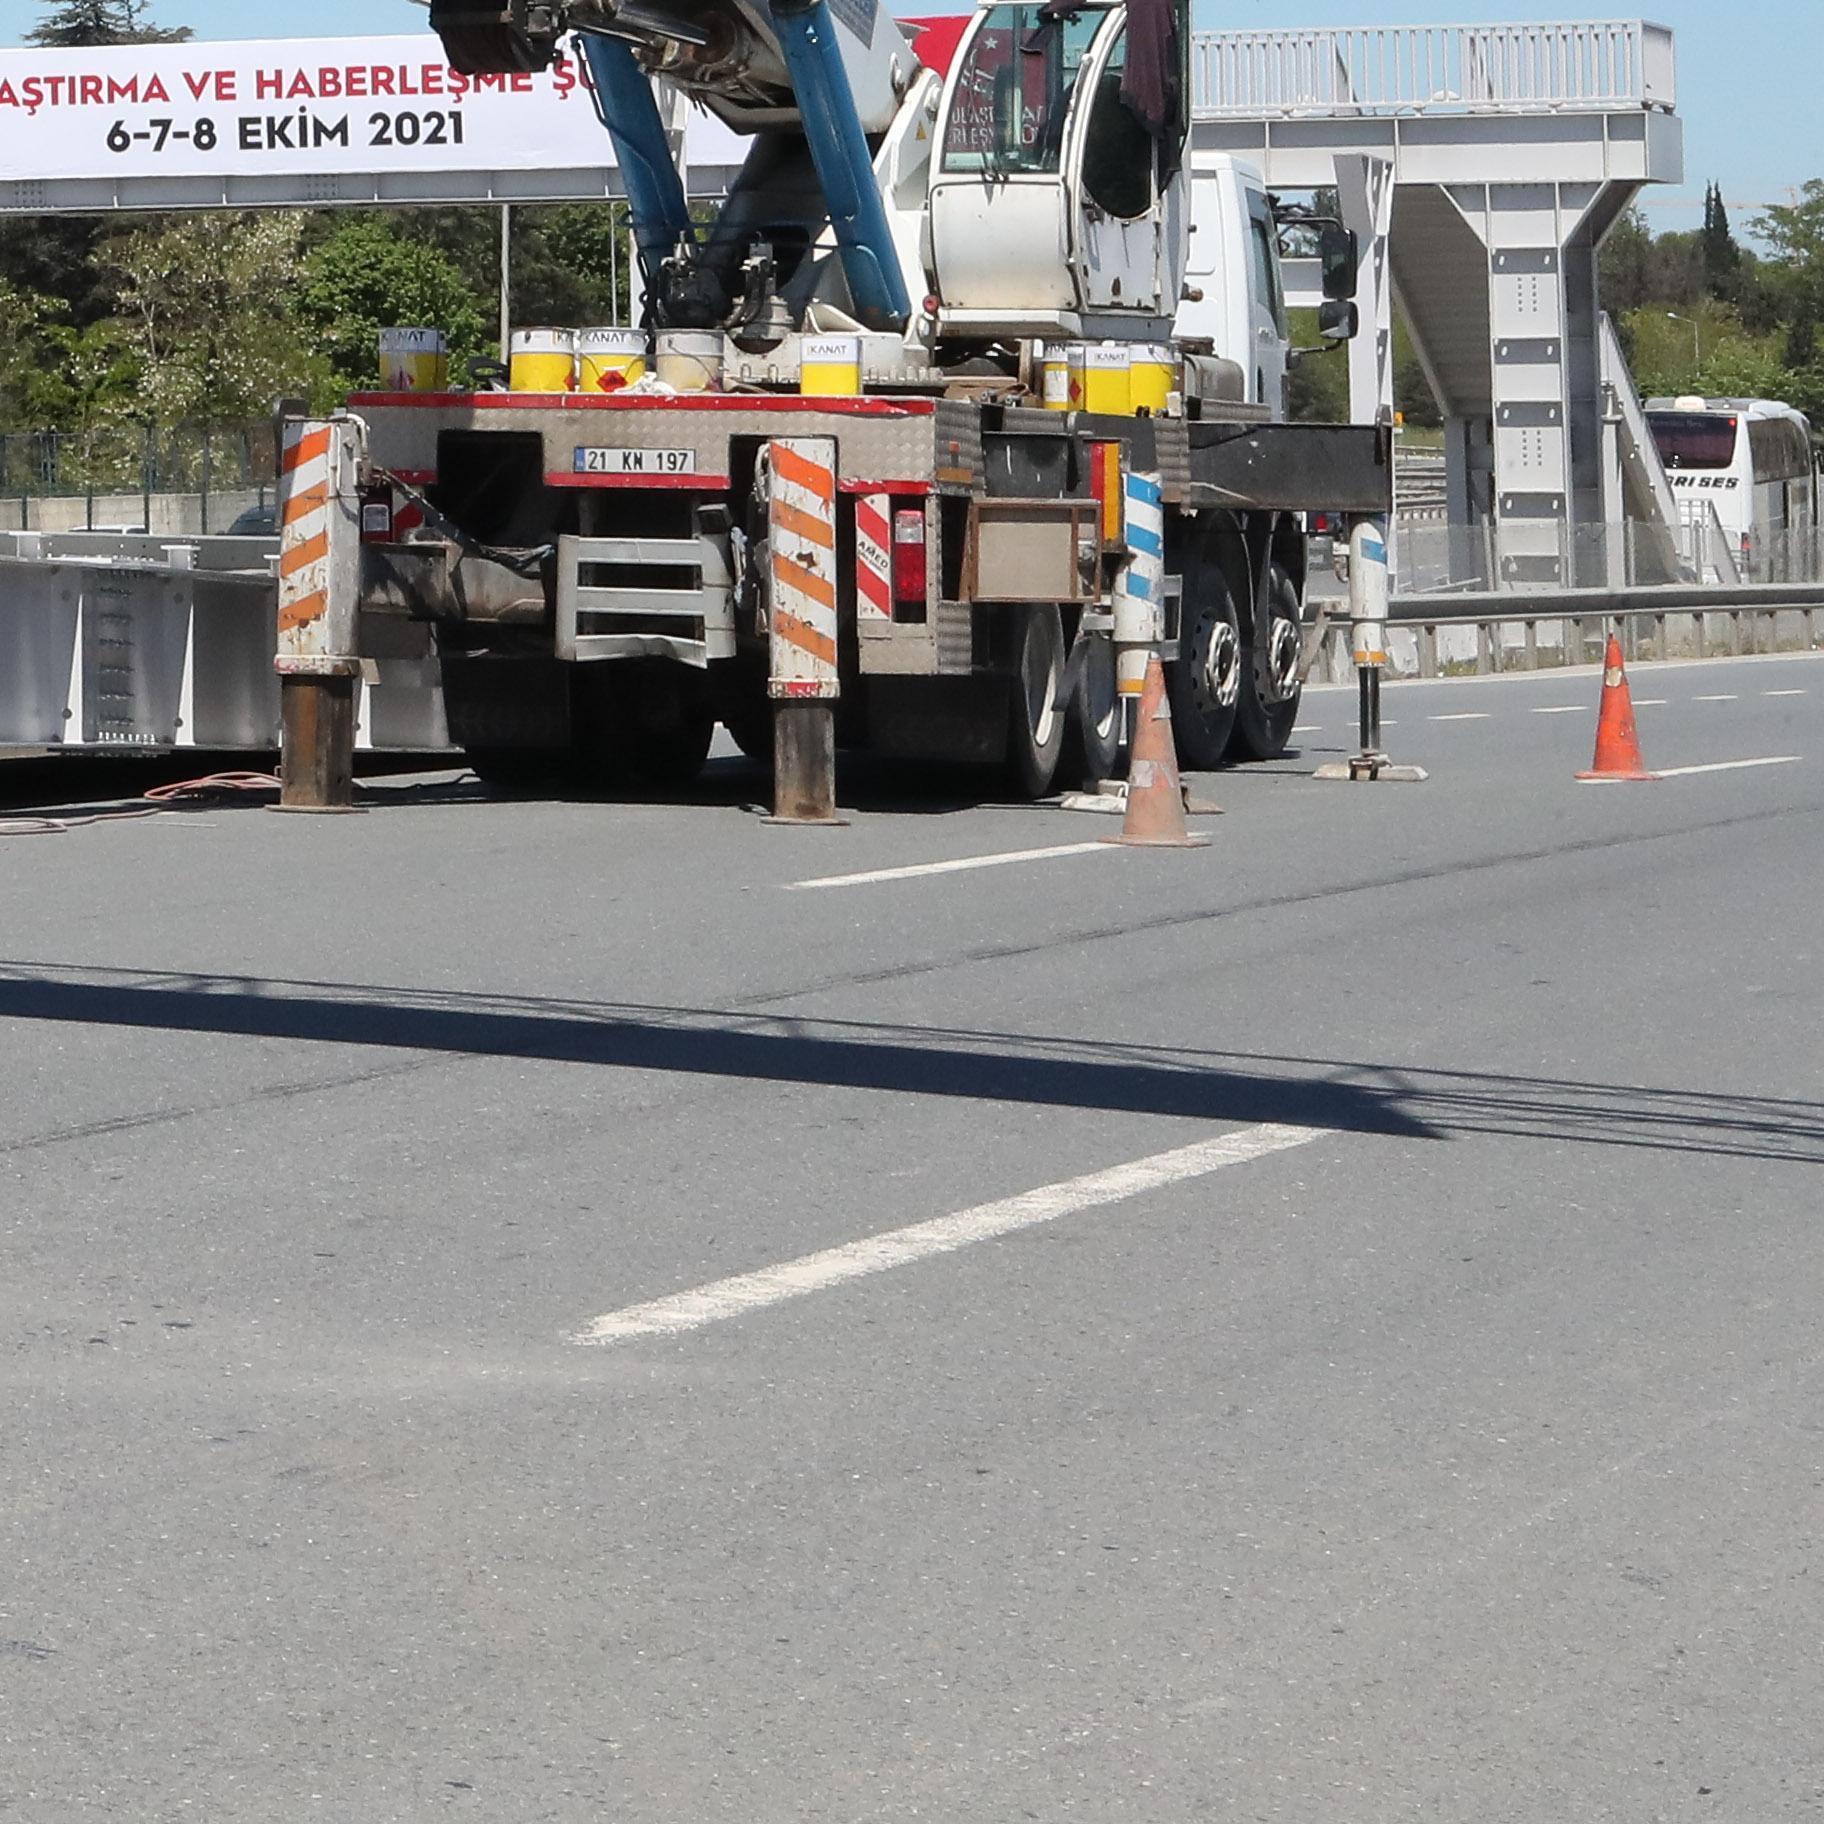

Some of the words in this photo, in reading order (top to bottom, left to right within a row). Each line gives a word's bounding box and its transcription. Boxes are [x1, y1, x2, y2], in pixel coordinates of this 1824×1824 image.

[182, 70, 238, 102] VE
[106, 118, 218, 153] 6-7-8
[238, 105, 349, 151] EKİM
[368, 111, 464, 146] 2021
[810, 345, 847, 354] KANAT
[588, 451, 607, 470] 21
[622, 451, 643, 471] KN
[657, 452, 688, 471] 197
